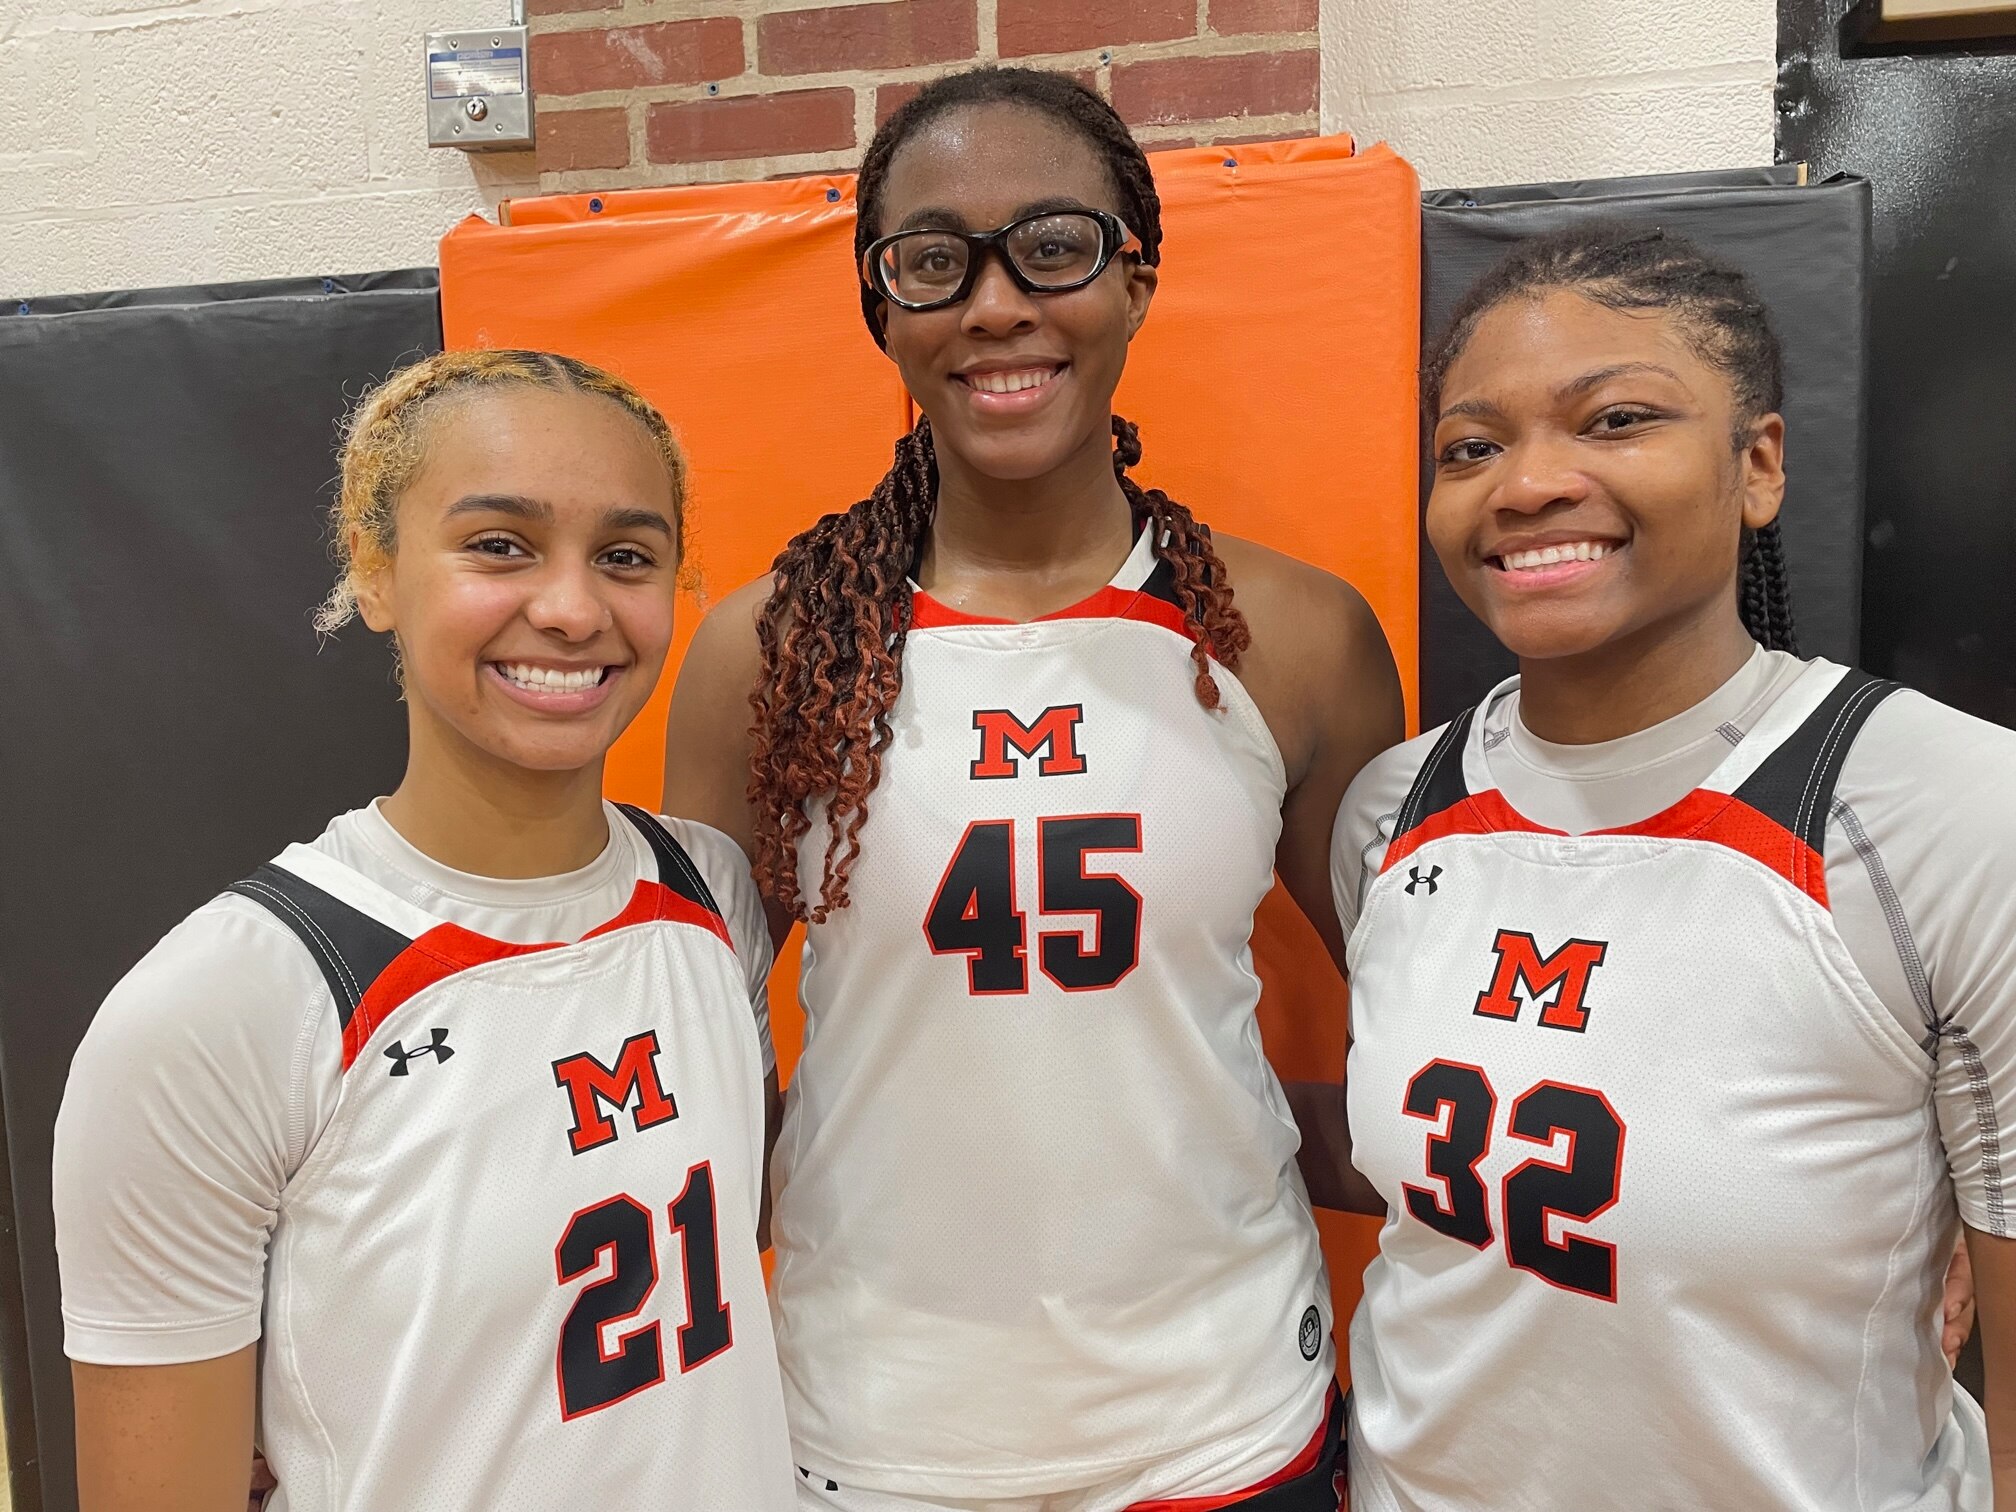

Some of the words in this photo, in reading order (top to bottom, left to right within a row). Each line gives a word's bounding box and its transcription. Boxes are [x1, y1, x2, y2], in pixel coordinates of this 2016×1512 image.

[970, 704, 1087, 780] M
[922, 812, 1143, 996] 45
[1473, 929, 1608, 1033] M
[552, 1030, 679, 1155] M
[1402, 1058, 1626, 1303] 32
[555, 1160, 733, 1422] 21
